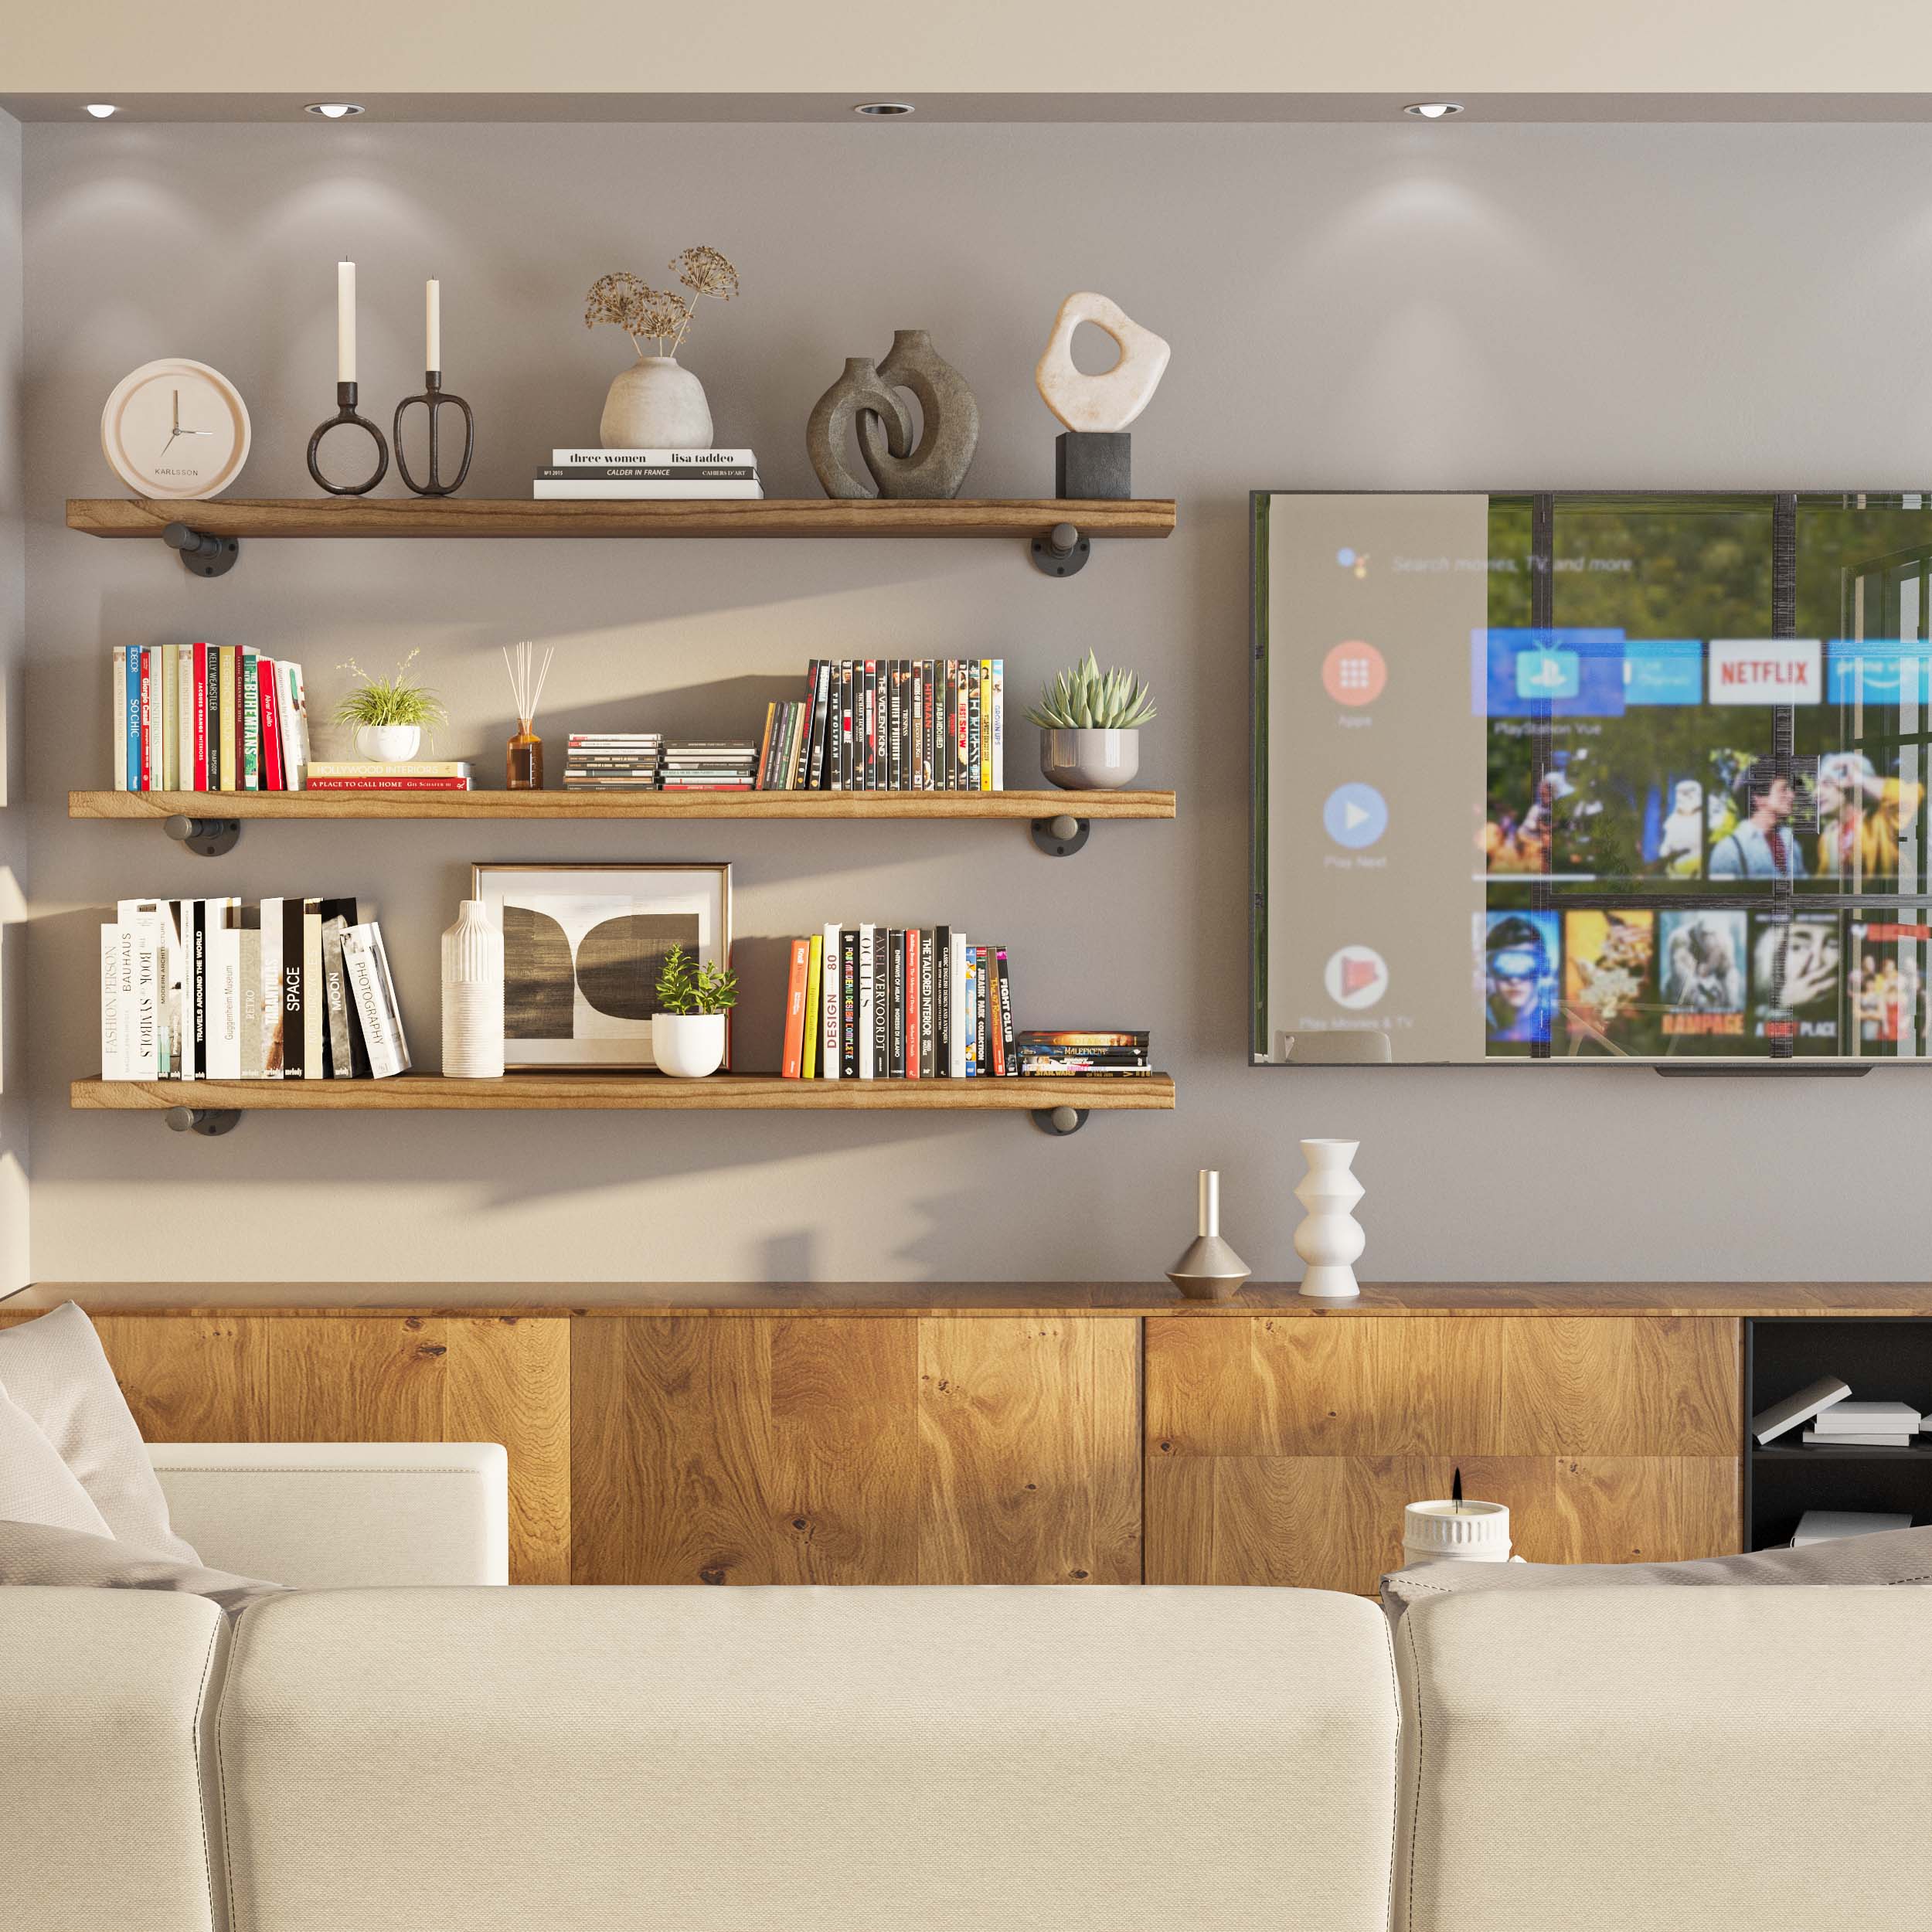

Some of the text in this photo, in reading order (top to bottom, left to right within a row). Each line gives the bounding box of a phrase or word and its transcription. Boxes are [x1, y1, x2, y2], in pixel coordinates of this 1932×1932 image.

[570, 453, 647, 463] three women
[671, 453, 734, 463] lisa taddeo
[1394, 557, 1449, 573] Search
[1553, 557, 1583, 572] and
[1590, 559, 1631, 572] more
[1721, 661, 1808, 685] NETFLIX
[131, 699, 139, 737] SO CHIC
[244, 684, 257, 754] BOHEMIANS
[970, 699, 980, 763] FORTRESS
[122, 932, 131, 992] BAUHAUS
[845, 947, 853, 993] POSTMODERN
[860, 937, 872, 1008] OCULUS
[876, 935, 885, 969] AXEL
[104, 946, 117, 1053] FASHION PERSON
[139, 952, 152, 1057] BOOK SYMBOLS
[224, 965, 235, 1040] Guggenheim Museum
[246, 990, 255, 1019] RETRO
[264, 958, 279, 1024] TARANTULAS
[287, 967, 300, 1012] SPACE
[329, 972, 341, 1011] MOON
[355, 962, 384, 1045] PHOTOGRAPHY
[827, 954, 837, 1049] DESIGN 80
[876, 973, 885, 1051] VERVOORDT
[923, 938, 931, 1036] THE TAILORED INTERIOR
[1000, 978, 1012, 1043] FIGHT CLUB
[1662, 1012, 1744, 1035] RAMPAGE
[1800, 1021, 1837, 1037] PLACE
